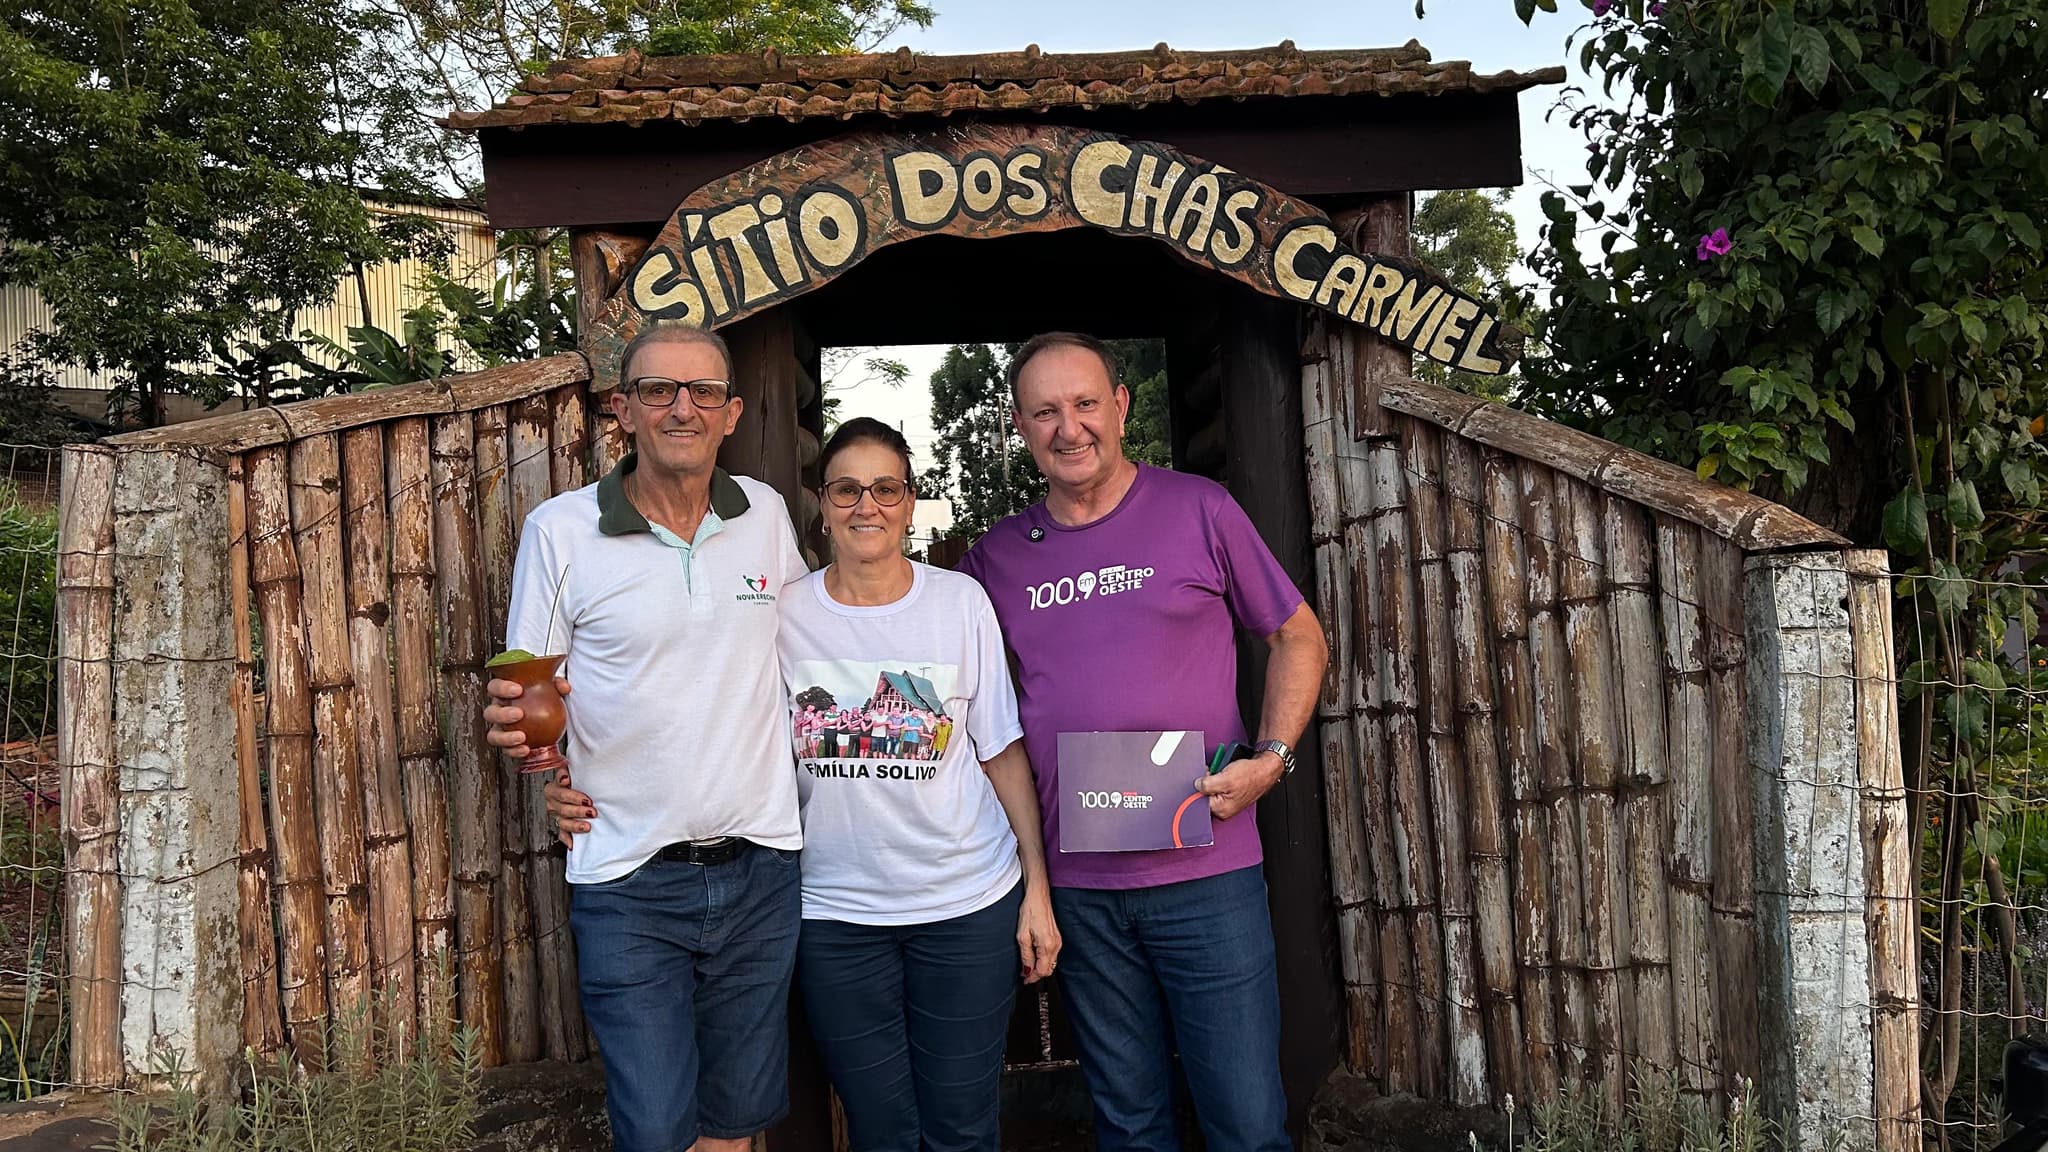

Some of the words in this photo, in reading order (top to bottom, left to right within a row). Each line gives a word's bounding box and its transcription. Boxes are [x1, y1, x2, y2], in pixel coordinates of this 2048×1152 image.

[891, 150, 1049, 226] DOS
[1069, 140, 1260, 265] CHÁS
[1273, 224, 1502, 374] CARNIEL
[1099, 567, 1155, 585] CENTRO
[1026, 571, 1097, 611] 100.9
[1099, 579, 1143, 596] OESTE
[804, 761, 870, 779] FMÍLIA
[876, 764, 937, 780] SOLIVO
[1077, 791, 1123, 809] 100.9
